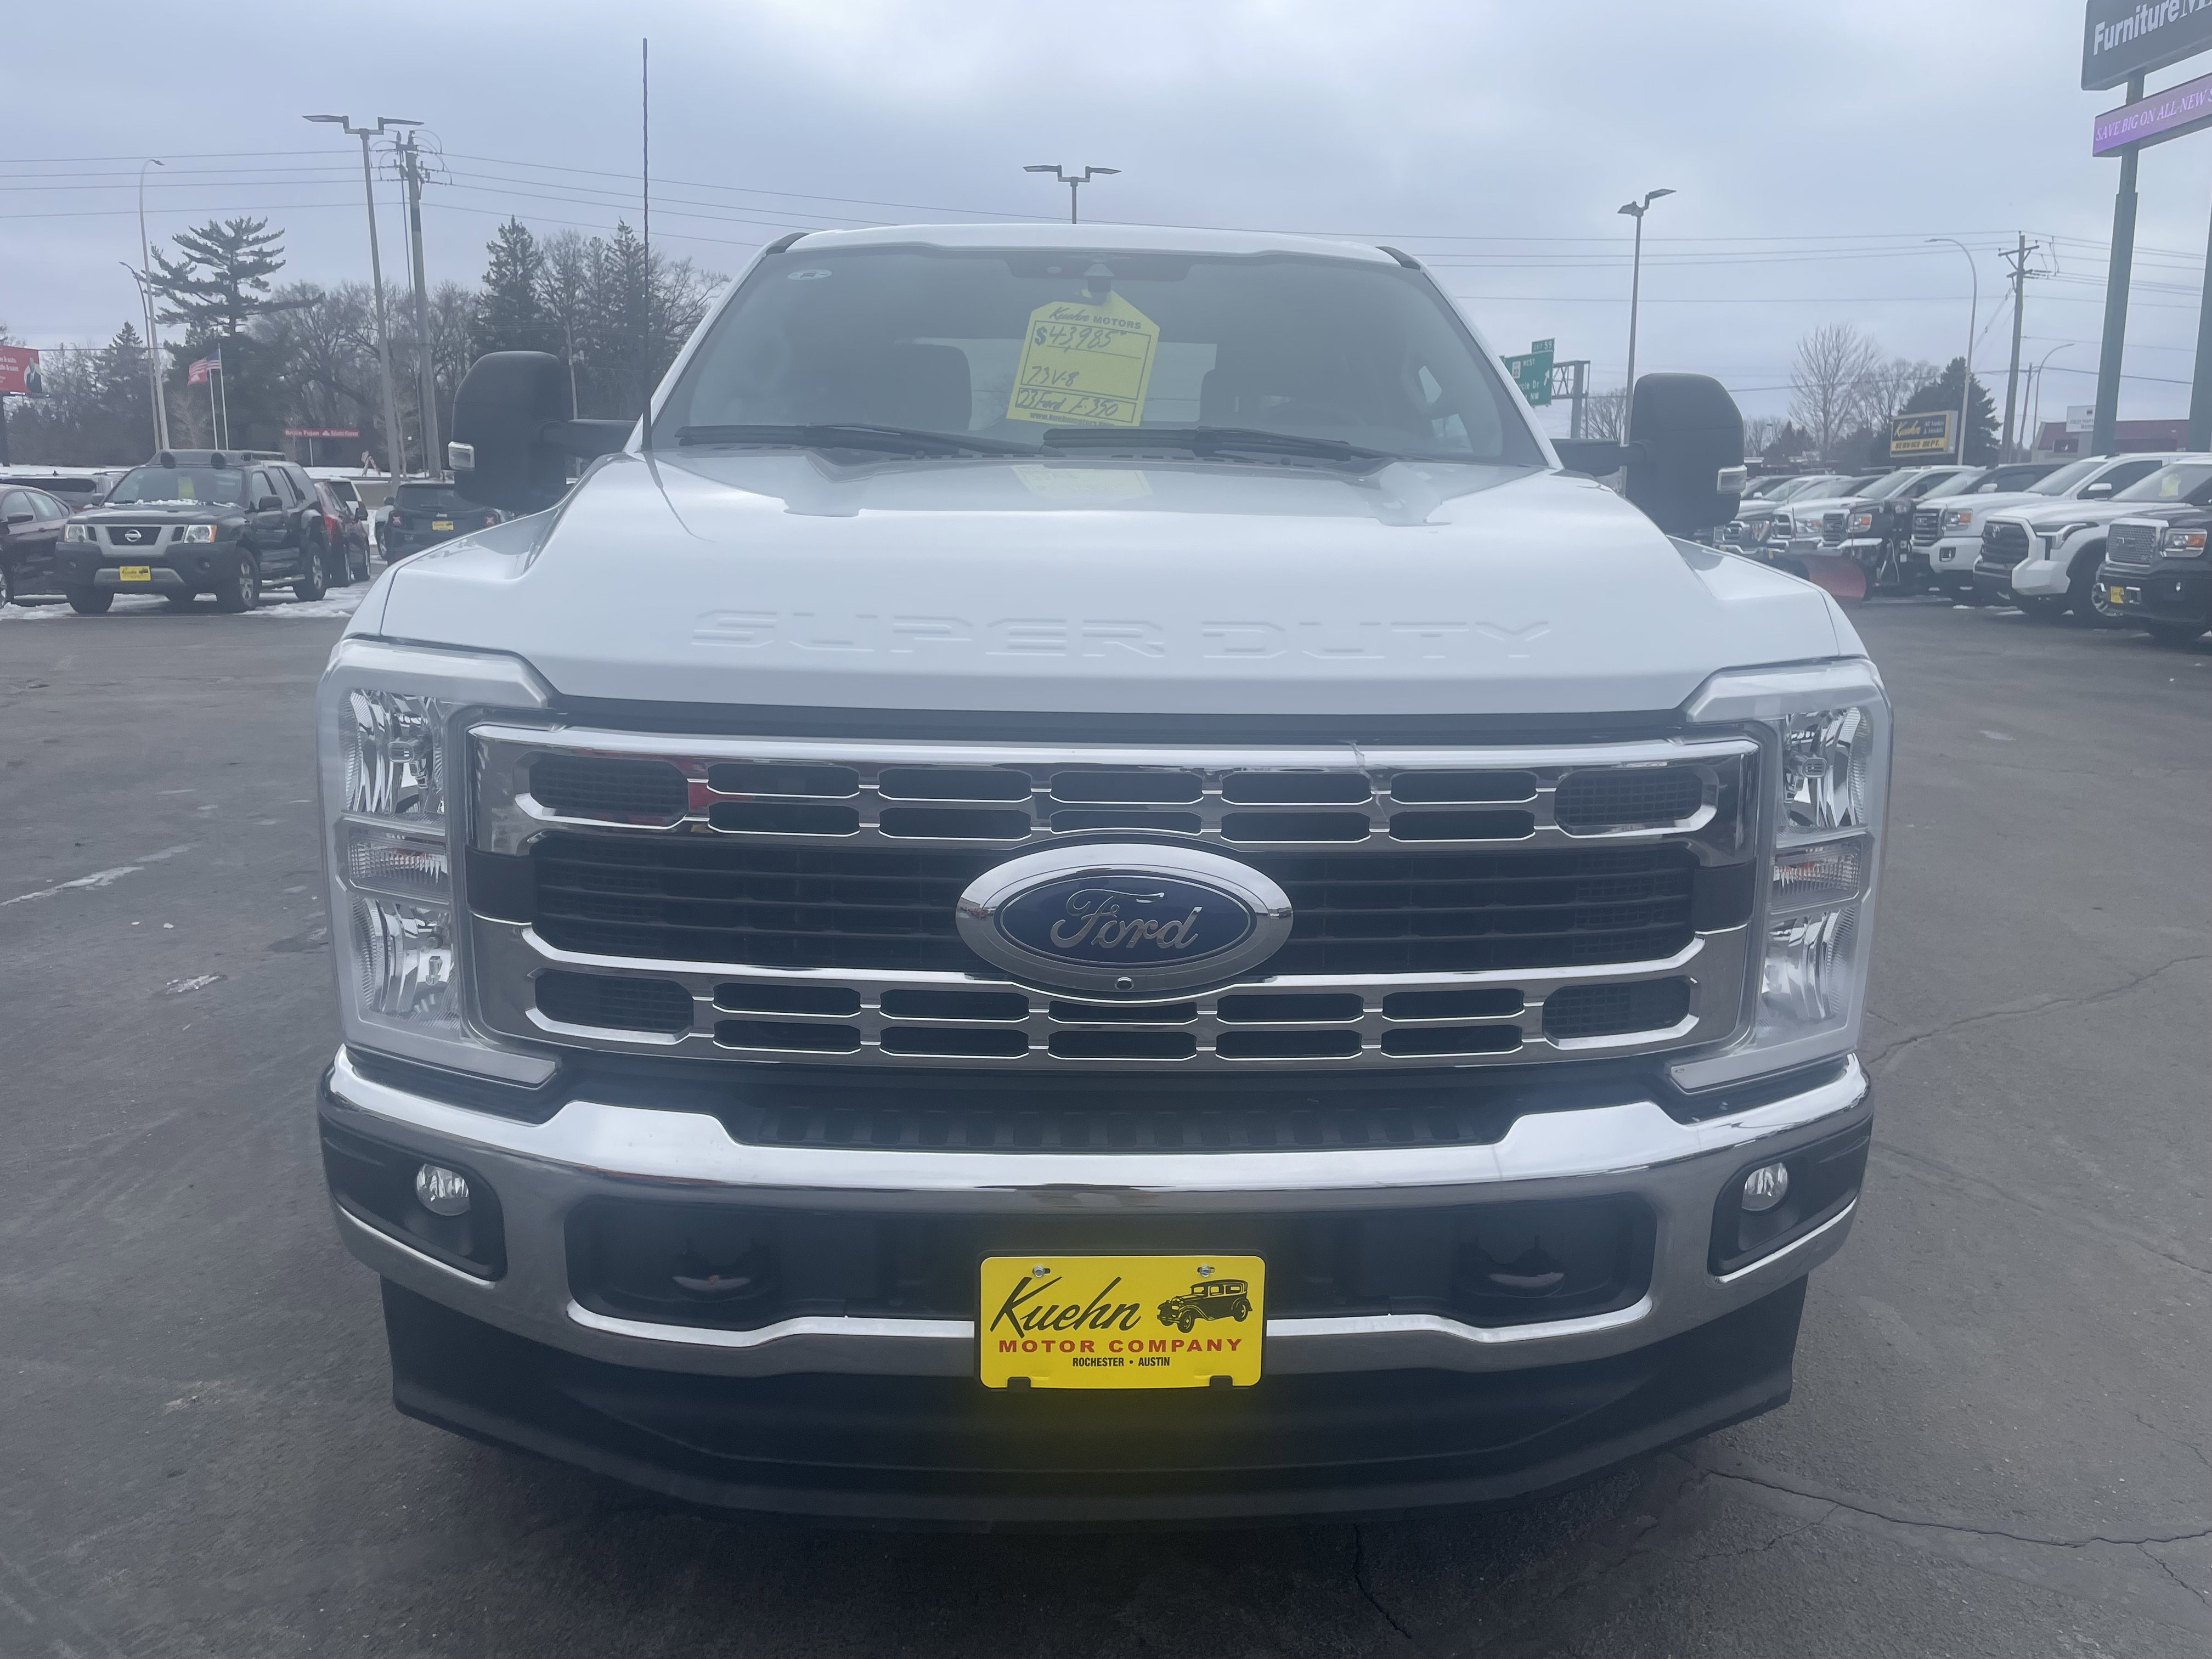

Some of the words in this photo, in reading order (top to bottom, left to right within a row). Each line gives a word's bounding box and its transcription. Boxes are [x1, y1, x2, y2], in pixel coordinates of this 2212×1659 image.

[2093, 0, 2212, 55] Furniture
[2095, 120, 2121, 142] SAVE
[2121, 114, 2138, 134] BIG
[2140, 108, 2157, 126] ON
[1049, 307, 1090, 321] Kuehn
[1092, 315, 1142, 329] MOTORS
[1523, 358, 1535, 366] WEST
[1519, 381, 1530, 390] rcle
[1532, 380, 1539, 389] Dr
[1034, 390, 1067, 410] Ford
[1531, 392, 1539, 400] NW
[690, 609, 1165, 658] SUPER
[1201, 620, 1551, 659] DUTY
[1050, 888, 1203, 949] Ford
[990, 1276, 1141, 1339] Kuehn
[998, 1340, 1096, 1353] MOTOR
[1108, 1339, 1243, 1353] COMPANY
[1073, 1357, 1124, 1367] ROCHESTER
[1138, 1356, 1170, 1367] AUSTIN
